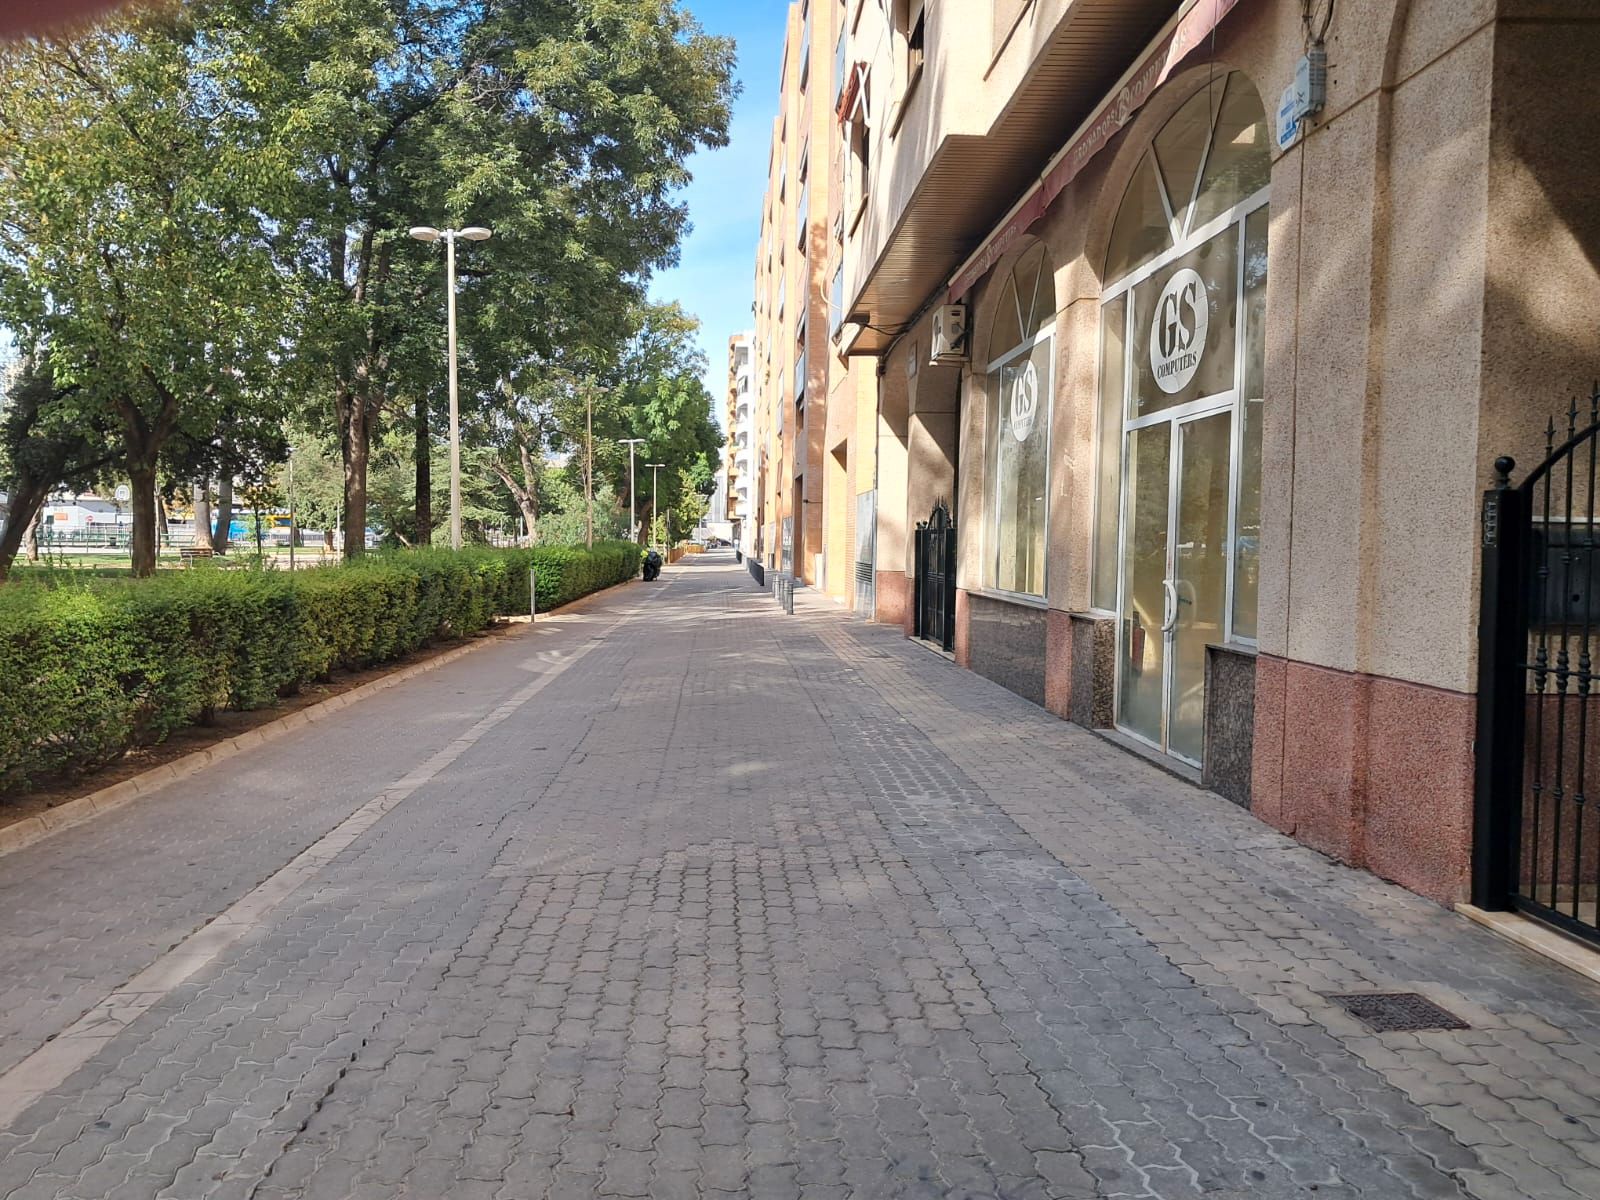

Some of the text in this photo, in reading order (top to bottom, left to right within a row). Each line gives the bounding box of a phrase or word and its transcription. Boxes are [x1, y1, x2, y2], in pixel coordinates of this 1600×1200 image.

[1158, 280, 1197, 359] GS
[1157, 350, 1198, 379] COMPUTERS
[1014, 369, 1033, 417] GS
